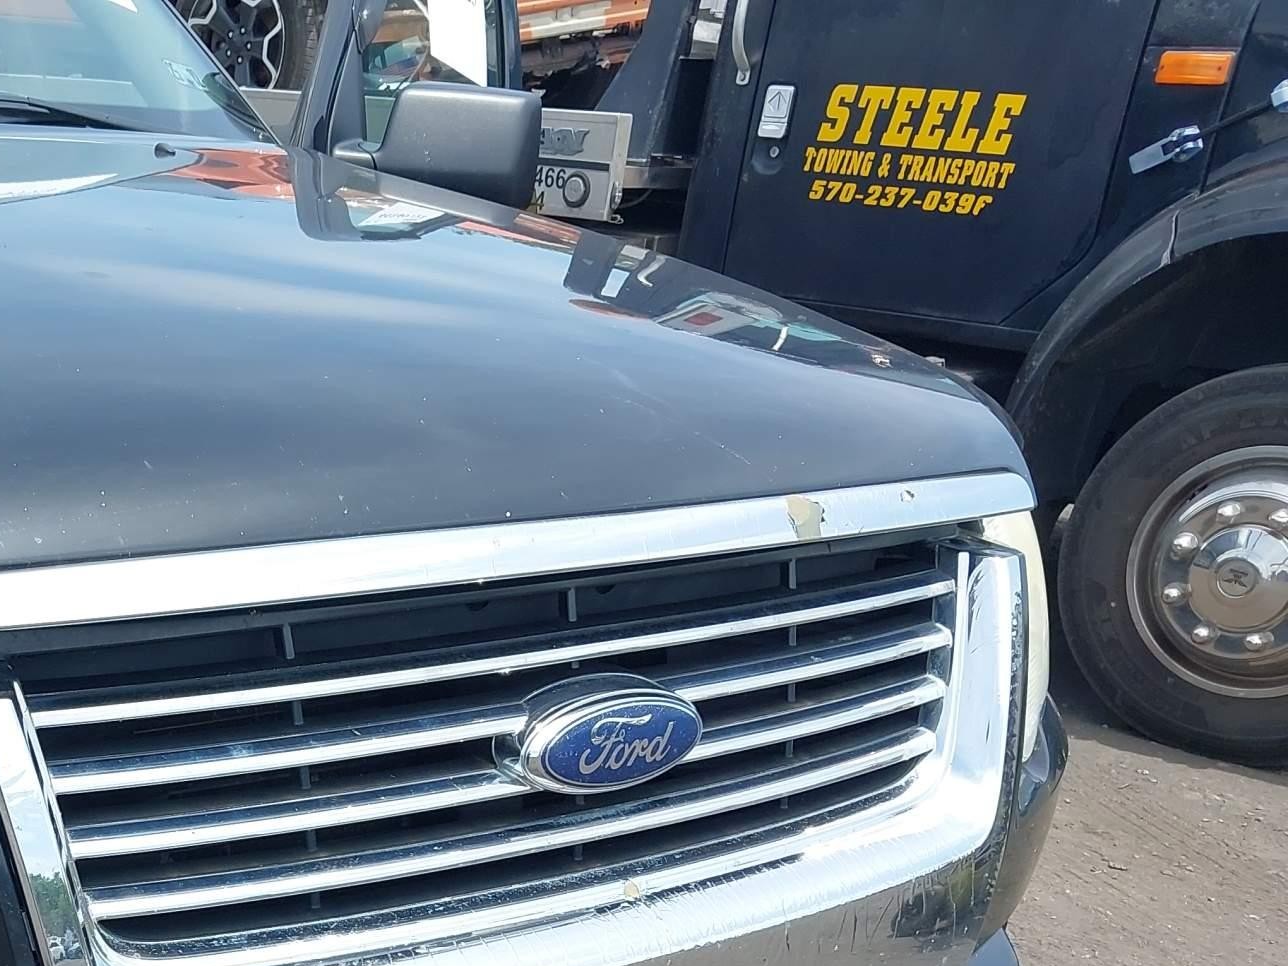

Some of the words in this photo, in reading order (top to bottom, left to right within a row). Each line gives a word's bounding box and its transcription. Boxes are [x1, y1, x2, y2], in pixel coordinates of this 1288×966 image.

[816, 83, 1027, 156] STEELE
[803, 147, 876, 177] TOWING
[877, 152, 892, 179] &
[897, 153, 1016, 189] TRANSPORT
[578, 713, 674, 775] Ford
